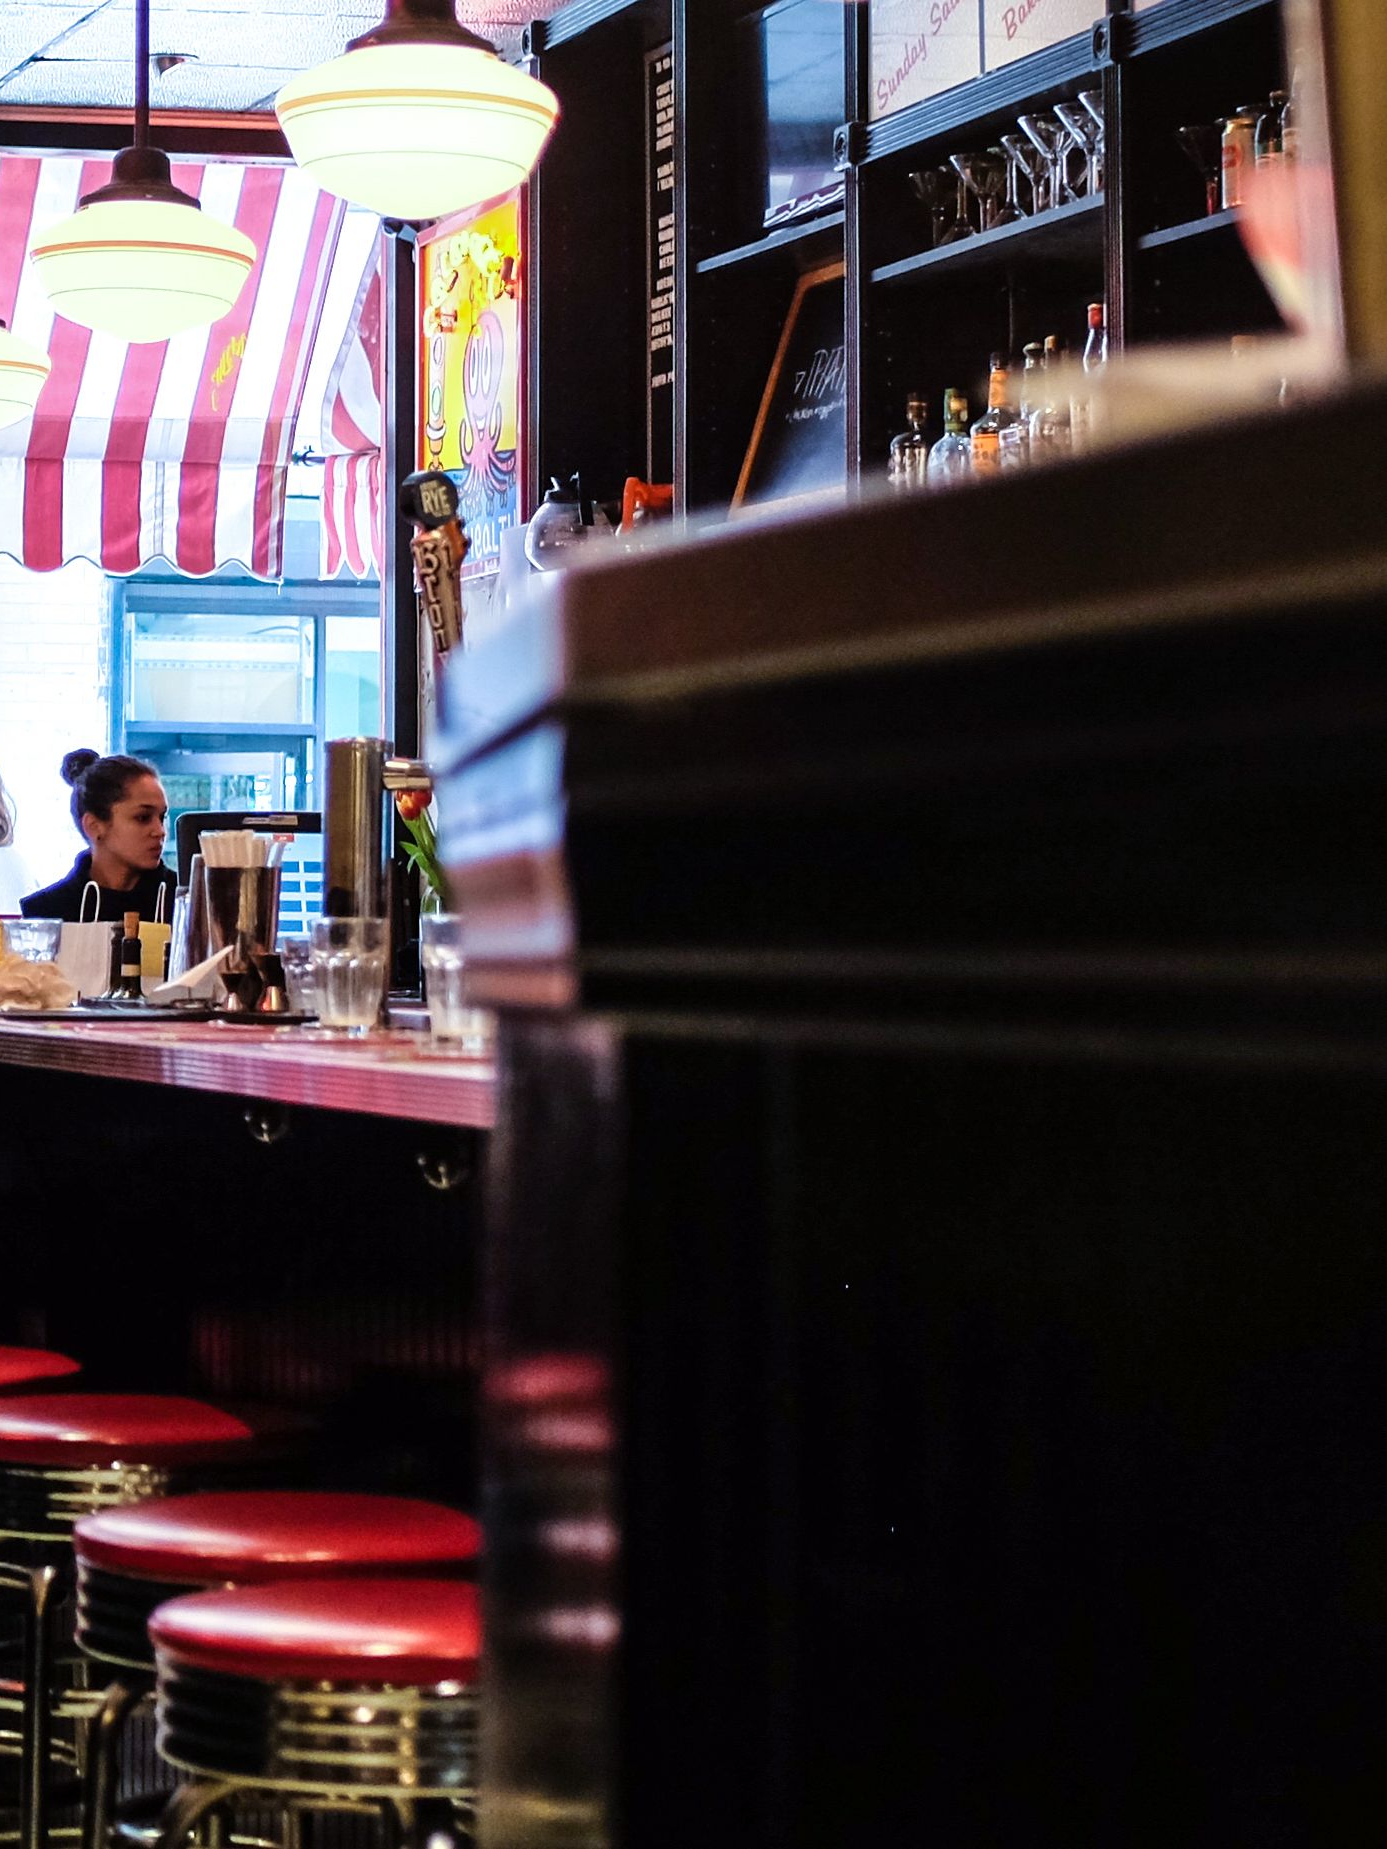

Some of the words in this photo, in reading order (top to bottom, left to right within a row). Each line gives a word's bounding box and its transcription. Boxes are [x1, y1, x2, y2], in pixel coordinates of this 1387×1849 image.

[1001, 0, 1043, 41] Bak
[875, 33, 927, 110] Sunday
[422, 486, 451, 514] RYE
